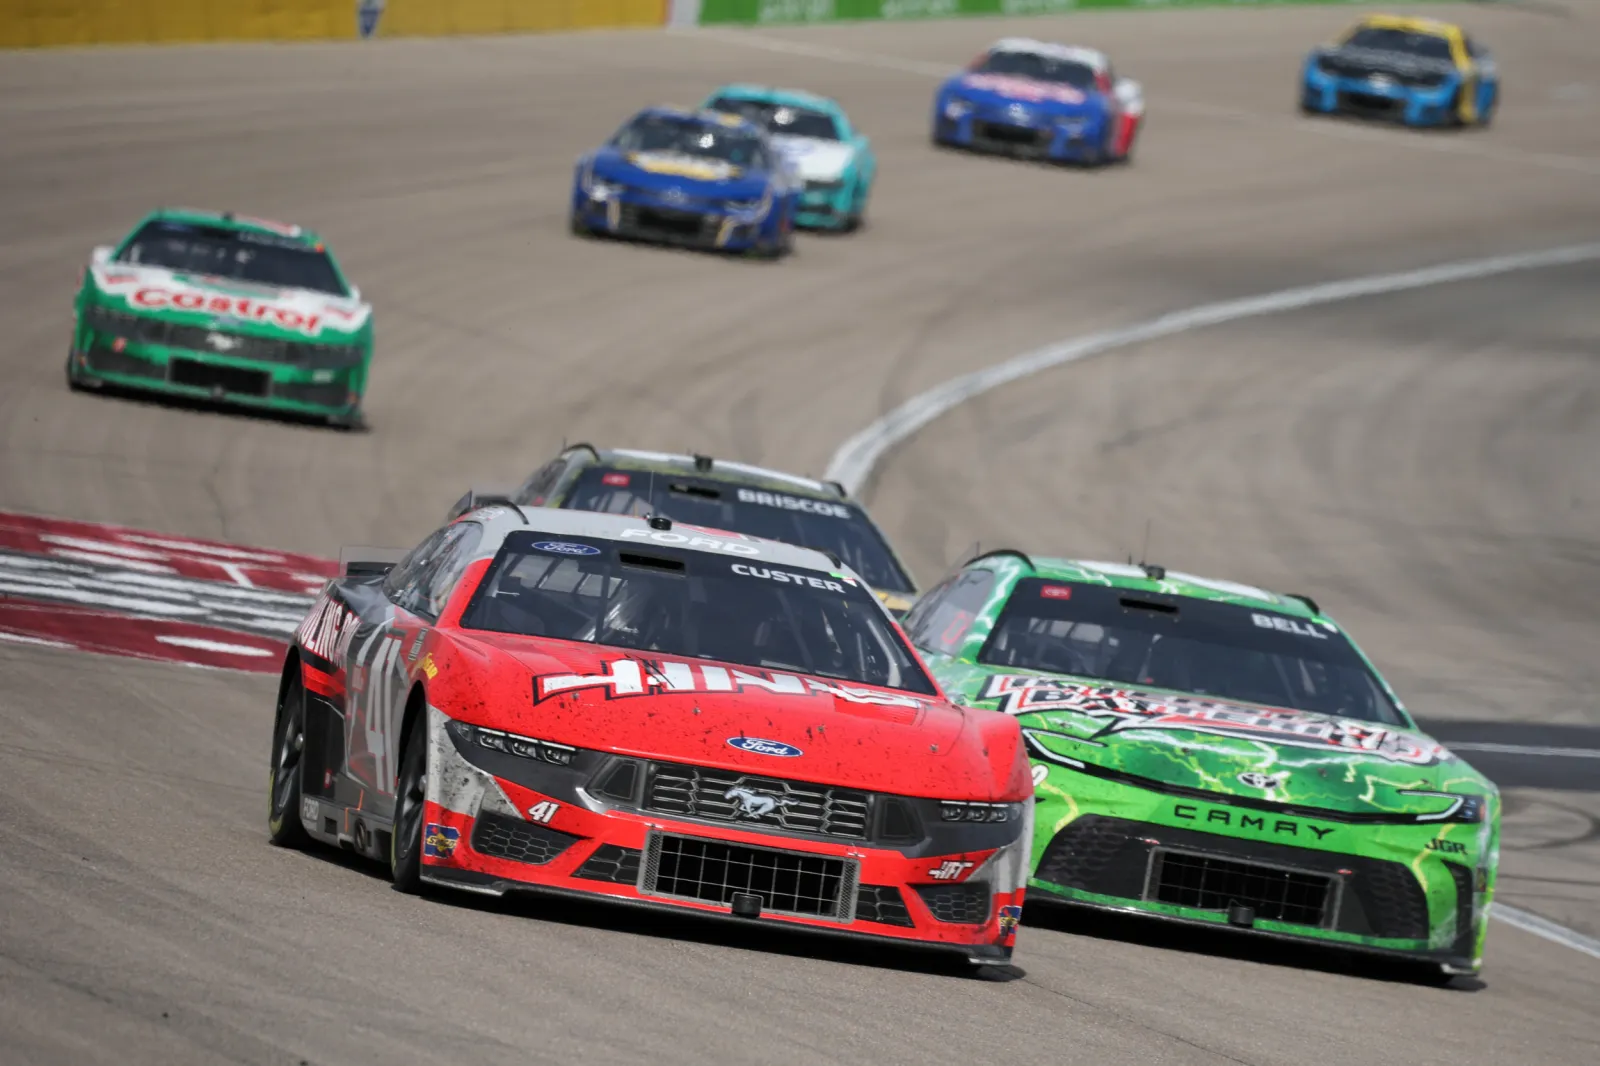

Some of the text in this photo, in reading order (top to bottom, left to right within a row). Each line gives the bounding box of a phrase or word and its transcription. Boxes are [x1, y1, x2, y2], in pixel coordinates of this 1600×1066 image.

[132, 288, 321, 333] Castrol
[737, 489, 851, 518] BRISCOE
[542, 541, 590, 554] Ford
[619, 528, 761, 555] FORD
[730, 563, 846, 594] CUSTER
[1251, 613, 1328, 639] BELL
[741, 738, 789, 755] Ford
[527, 801, 559, 824] 41
[1424, 838, 1469, 855] JGR
